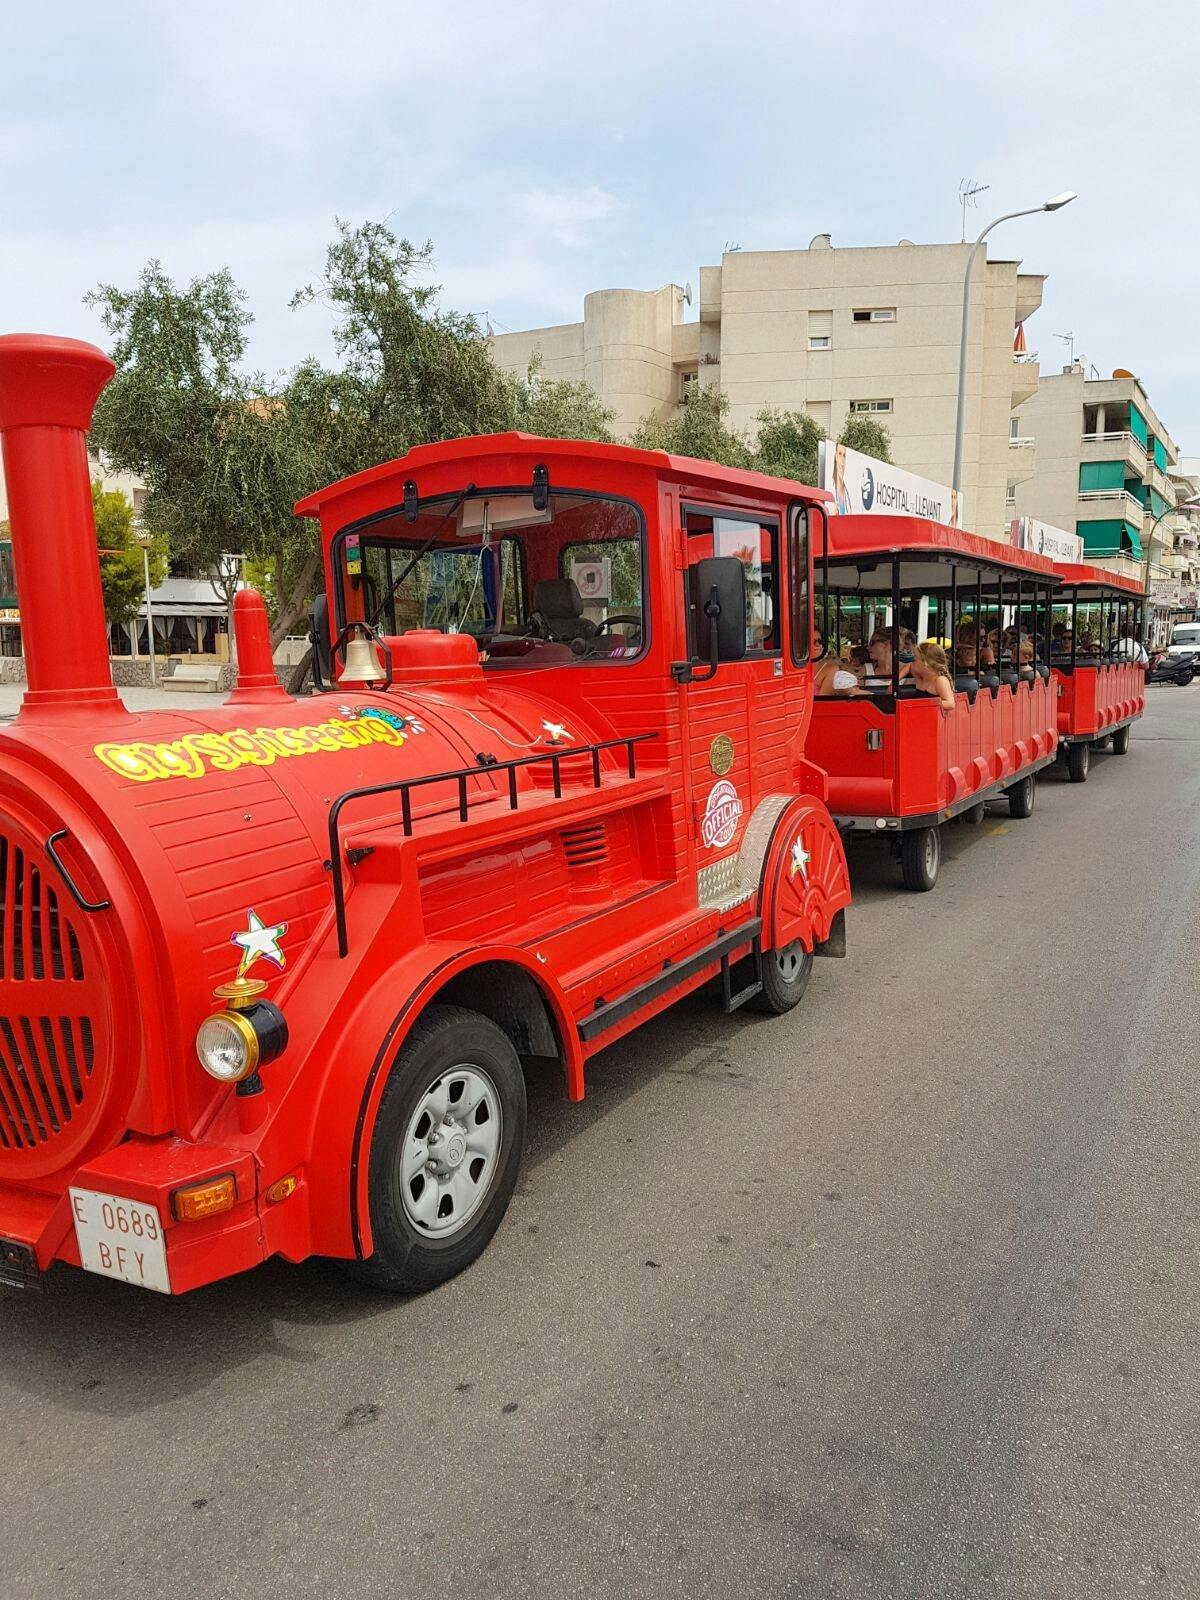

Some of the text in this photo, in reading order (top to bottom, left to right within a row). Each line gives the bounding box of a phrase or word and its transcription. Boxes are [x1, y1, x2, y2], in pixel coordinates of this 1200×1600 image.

[876, 482, 941, 520] HOSPITAL LLEVANT
[705, 801, 742, 840] OFFICIAL
[73, 1196, 158, 1240] E 0689
[98, 1242, 144, 1278] BFY
